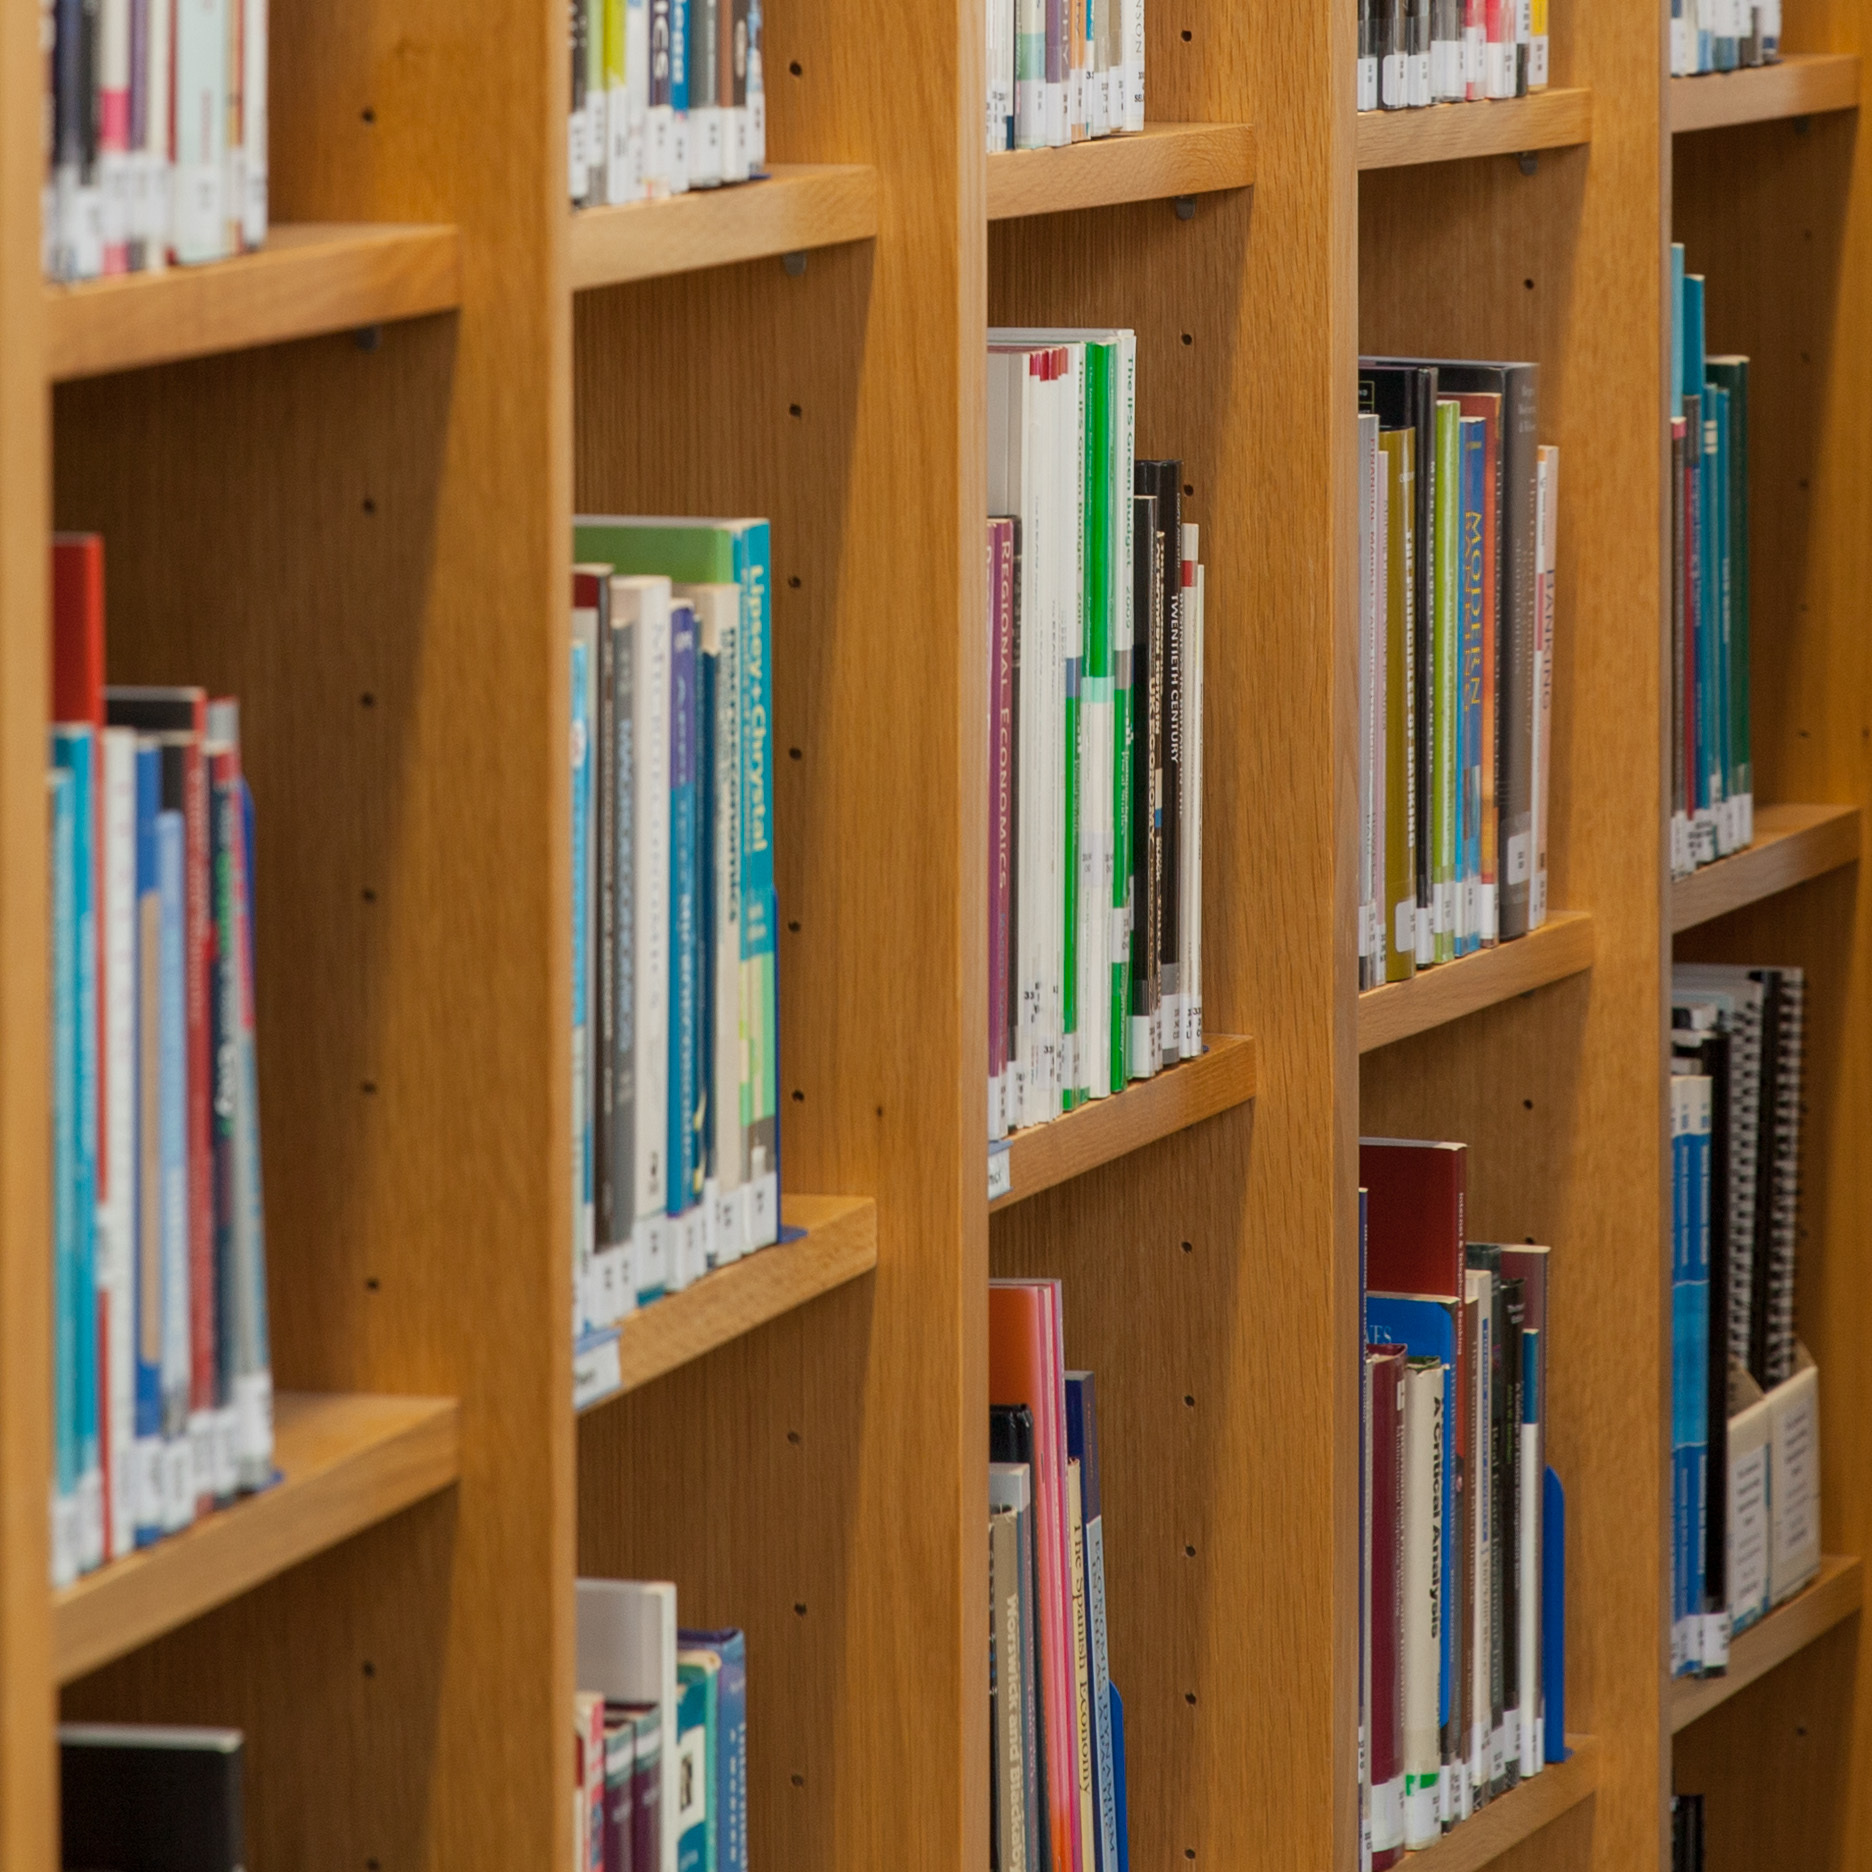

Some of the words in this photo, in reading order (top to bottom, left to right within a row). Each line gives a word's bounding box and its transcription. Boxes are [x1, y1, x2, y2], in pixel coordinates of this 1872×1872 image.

[1126, 355, 1134, 392] The
[1126, 397, 1134, 427] IFS
[1126, 432, 1134, 491] Green
[1076, 502, 1084, 574] Budget
[1125, 498, 1133, 568] Budget
[1000, 540, 1012, 686] REGIONAL
[1170, 594, 1179, 685] TWENTIETH
[1406, 576, 1414, 708] PRINCIPLES
[1470, 511, 1482, 704] MODERN
[1542, 569, 1556, 710] BANKING
[748, 564, 768, 852] Lipsey+Chrystal
[1148, 677, 1156, 715] UK
[1170, 689, 1178, 763] CENTURY
[1407, 714, 1414, 738] OF
[1000, 709, 1010, 889] ECONOMICS
[1148, 720, 1156, 843] ECONOMY
[1408, 746, 1416, 848] BANKING
[1456, 1310, 1464, 1356] Banking
[1433, 1397, 1442, 1418] A
[1432, 1424, 1442, 1520] Critical
[1074, 1521, 1082, 1568] The
[1430, 1526, 1442, 1638] Analysis
[1006, 1593, 1018, 1710] Worswick
[1072, 1578, 1086, 1670] Spanish
[1008, 1714, 1019, 1762] and
[1080, 1681, 1090, 1795] Economy
[1094, 1539, 1108, 1686] ECONOMIC
[1104, 1692, 1116, 1853] DYNAMISM
[1010, 1768, 1022, 1872] Blackaby
